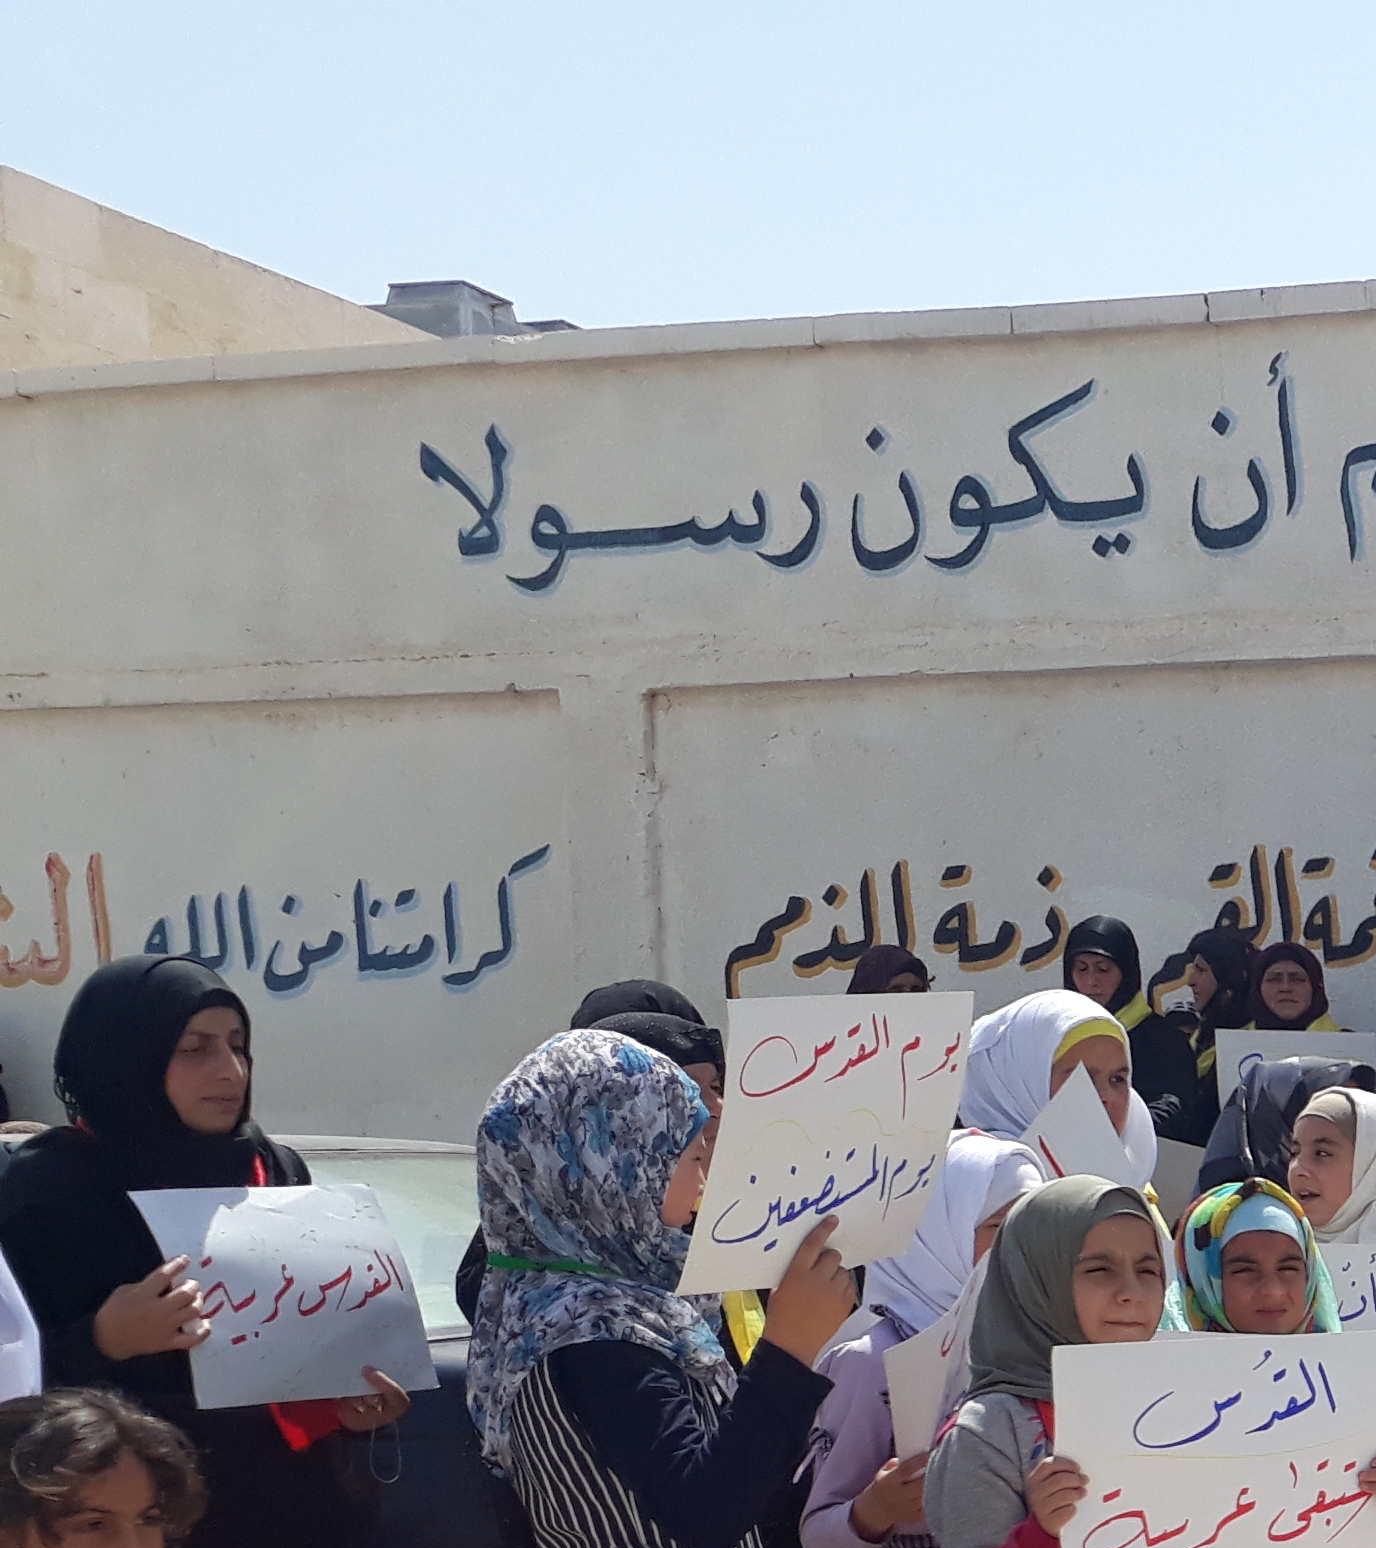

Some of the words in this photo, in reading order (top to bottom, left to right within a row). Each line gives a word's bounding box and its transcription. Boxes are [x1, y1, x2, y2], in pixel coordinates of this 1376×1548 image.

[853, 380, 1148, 572] يكون
[1192, 353, 1300, 552] أن
[419, 424, 822, 592] رسولا
[143, 884, 254, 969] الله
[263, 894, 343, 992] من
[355, 843, 551, 985] كرامتنا
[932, 865, 1063, 972] ذمة
[740, 1014, 890, 1098] القدس
[894, 1030, 963, 1121] يوم
[711, 1142, 888, 1252] المستضعفين
[298, 1249, 404, 1316] القدس
